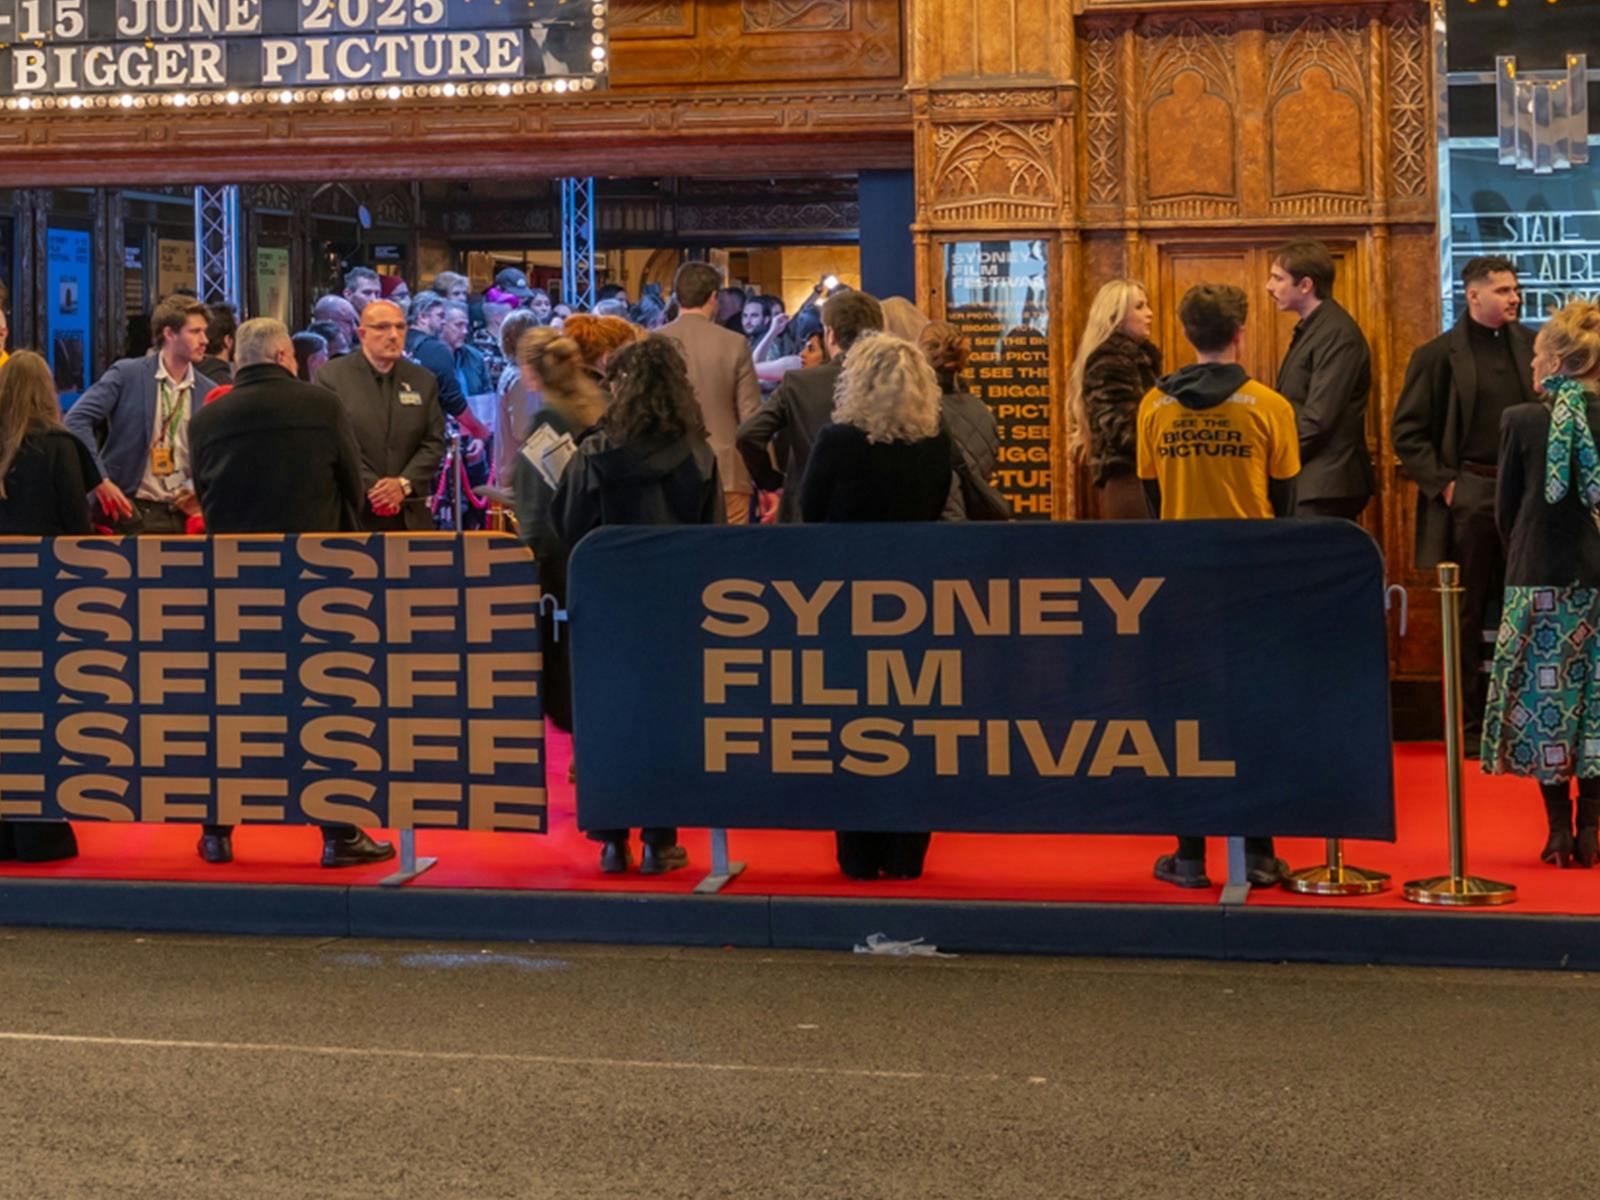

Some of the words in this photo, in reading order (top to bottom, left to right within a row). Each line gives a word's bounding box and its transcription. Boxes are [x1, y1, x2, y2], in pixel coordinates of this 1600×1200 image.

[12, 44, 225, 92] BIGGER
[263, 34, 521, 85] PICTURE
[951, 251, 1030, 264] SYDNEY
[951, 264, 999, 276] FILM
[980, 367, 1013, 378] SEE
[1163, 429, 1242, 444] BIGGER
[1158, 443, 1253, 459] PICTURE
[701, 578, 1165, 637] SYDNEY
[704, 649, 962, 706] FILM
[704, 718, 1236, 778] FESTIVAL
